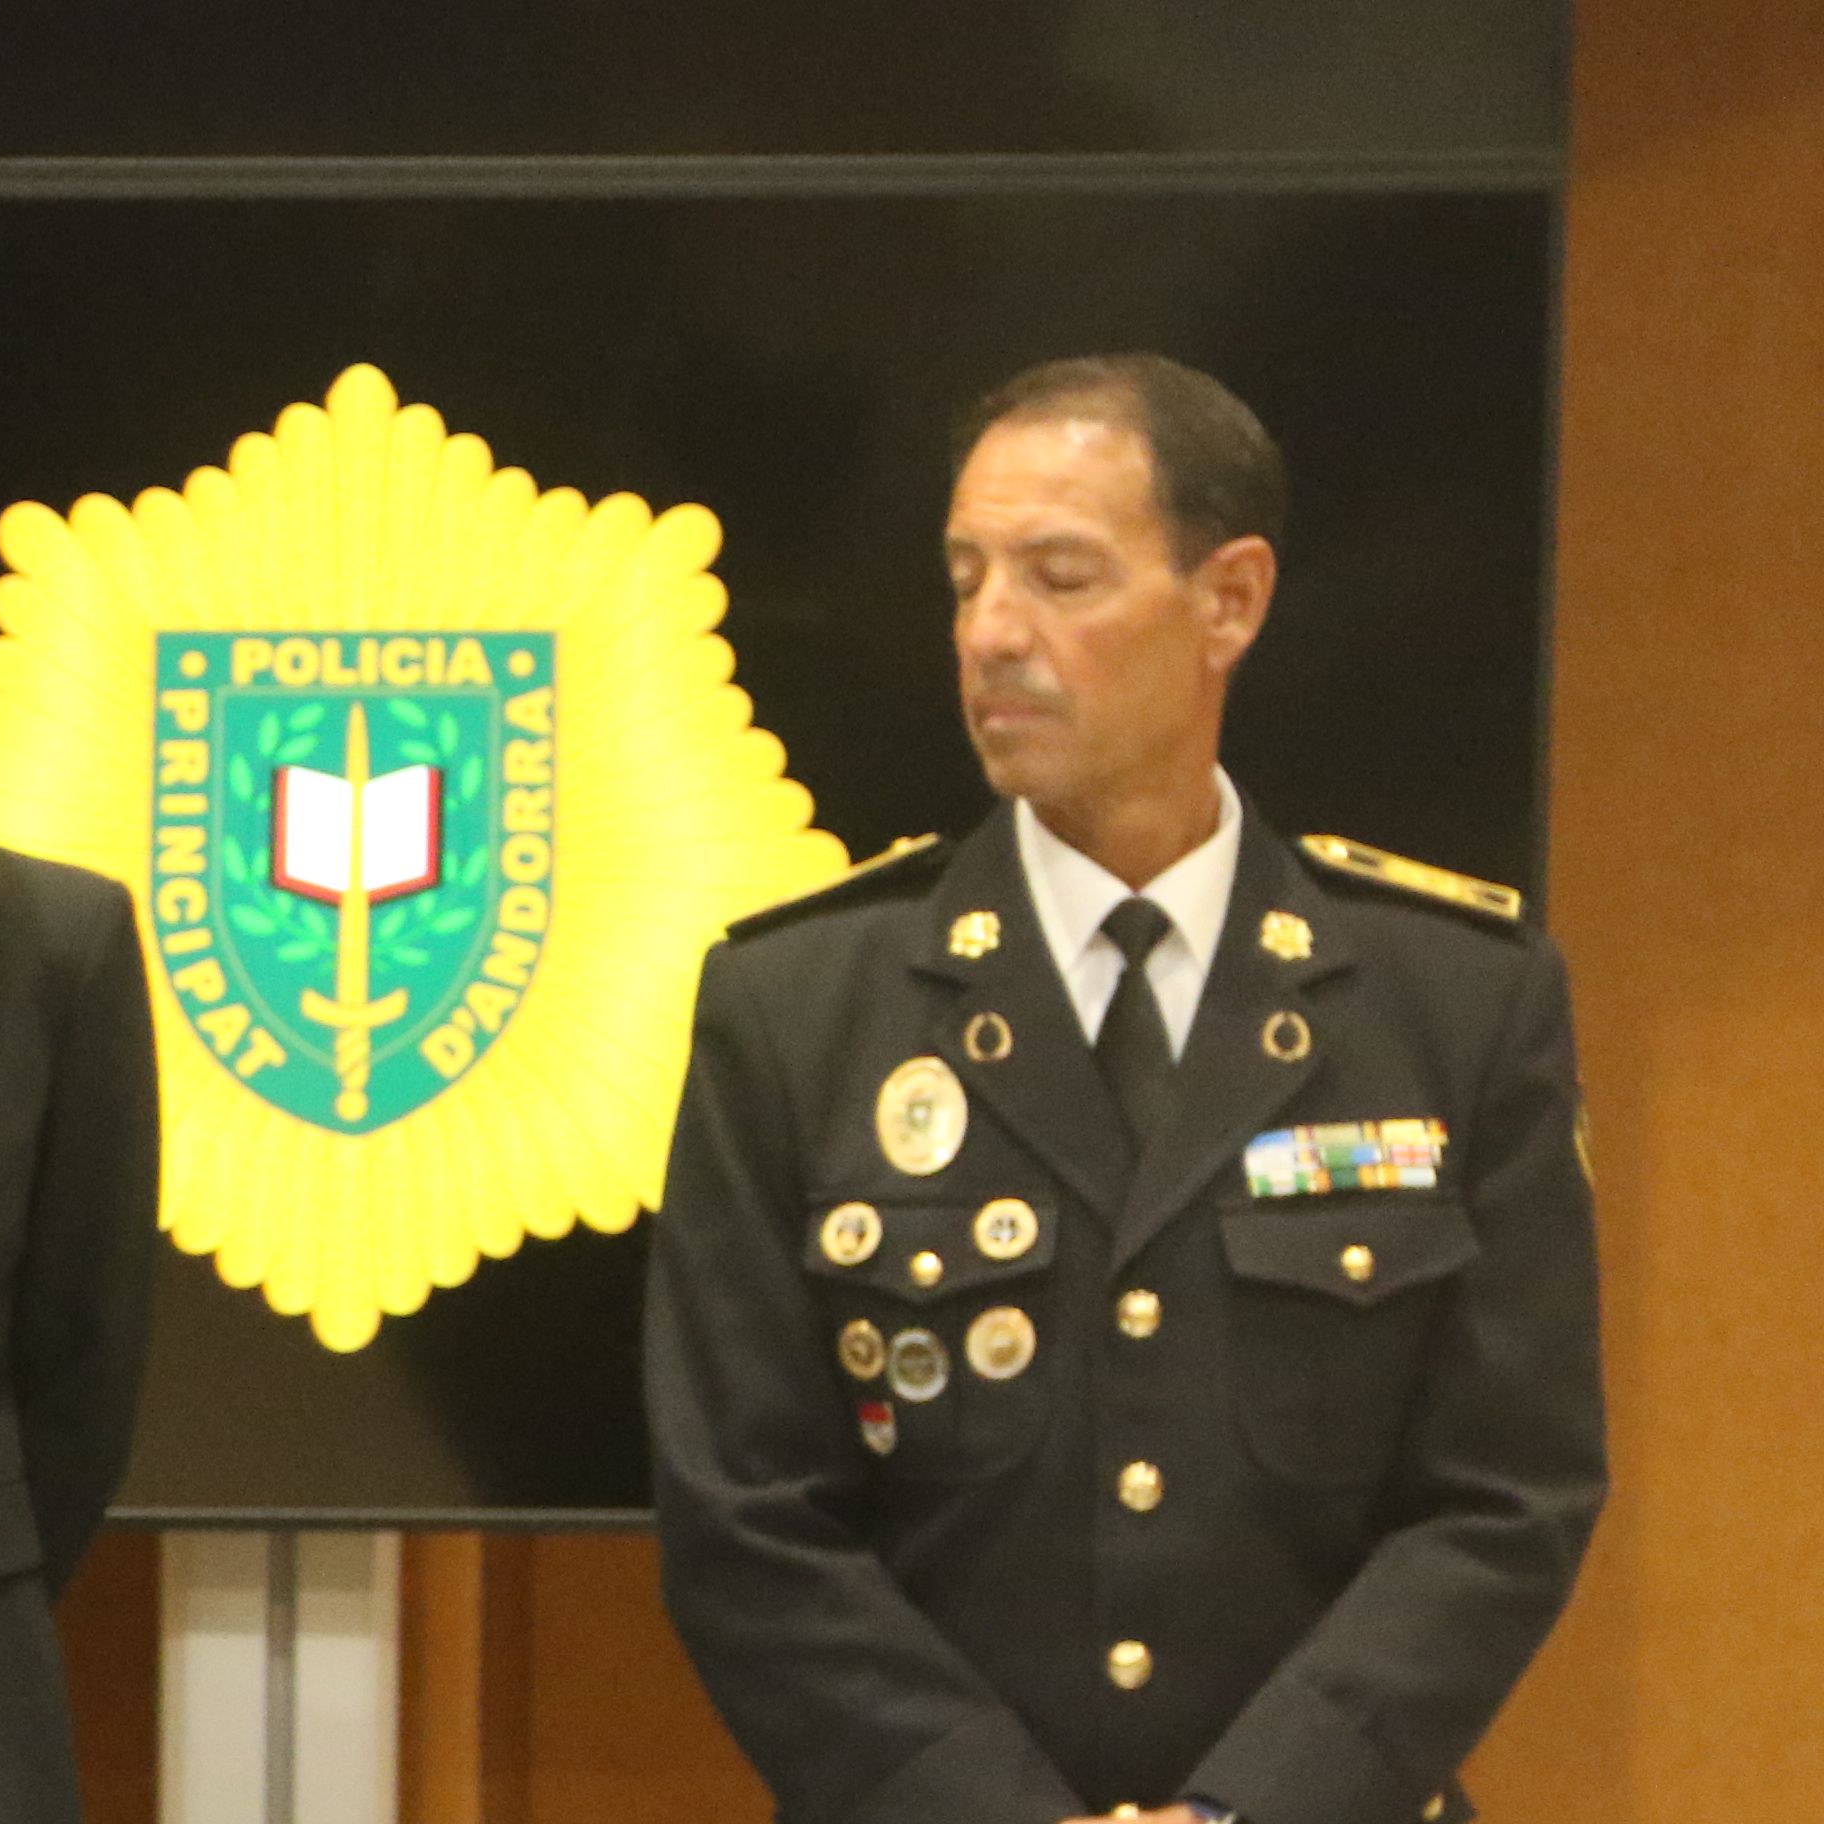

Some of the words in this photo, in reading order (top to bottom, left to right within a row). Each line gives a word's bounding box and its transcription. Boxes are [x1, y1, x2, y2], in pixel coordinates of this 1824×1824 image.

[232, 638, 494, 687] POLICIA
[156, 689, 287, 1080] PRINCIPAT
[419, 686, 555, 1080] D'ANDORRA
